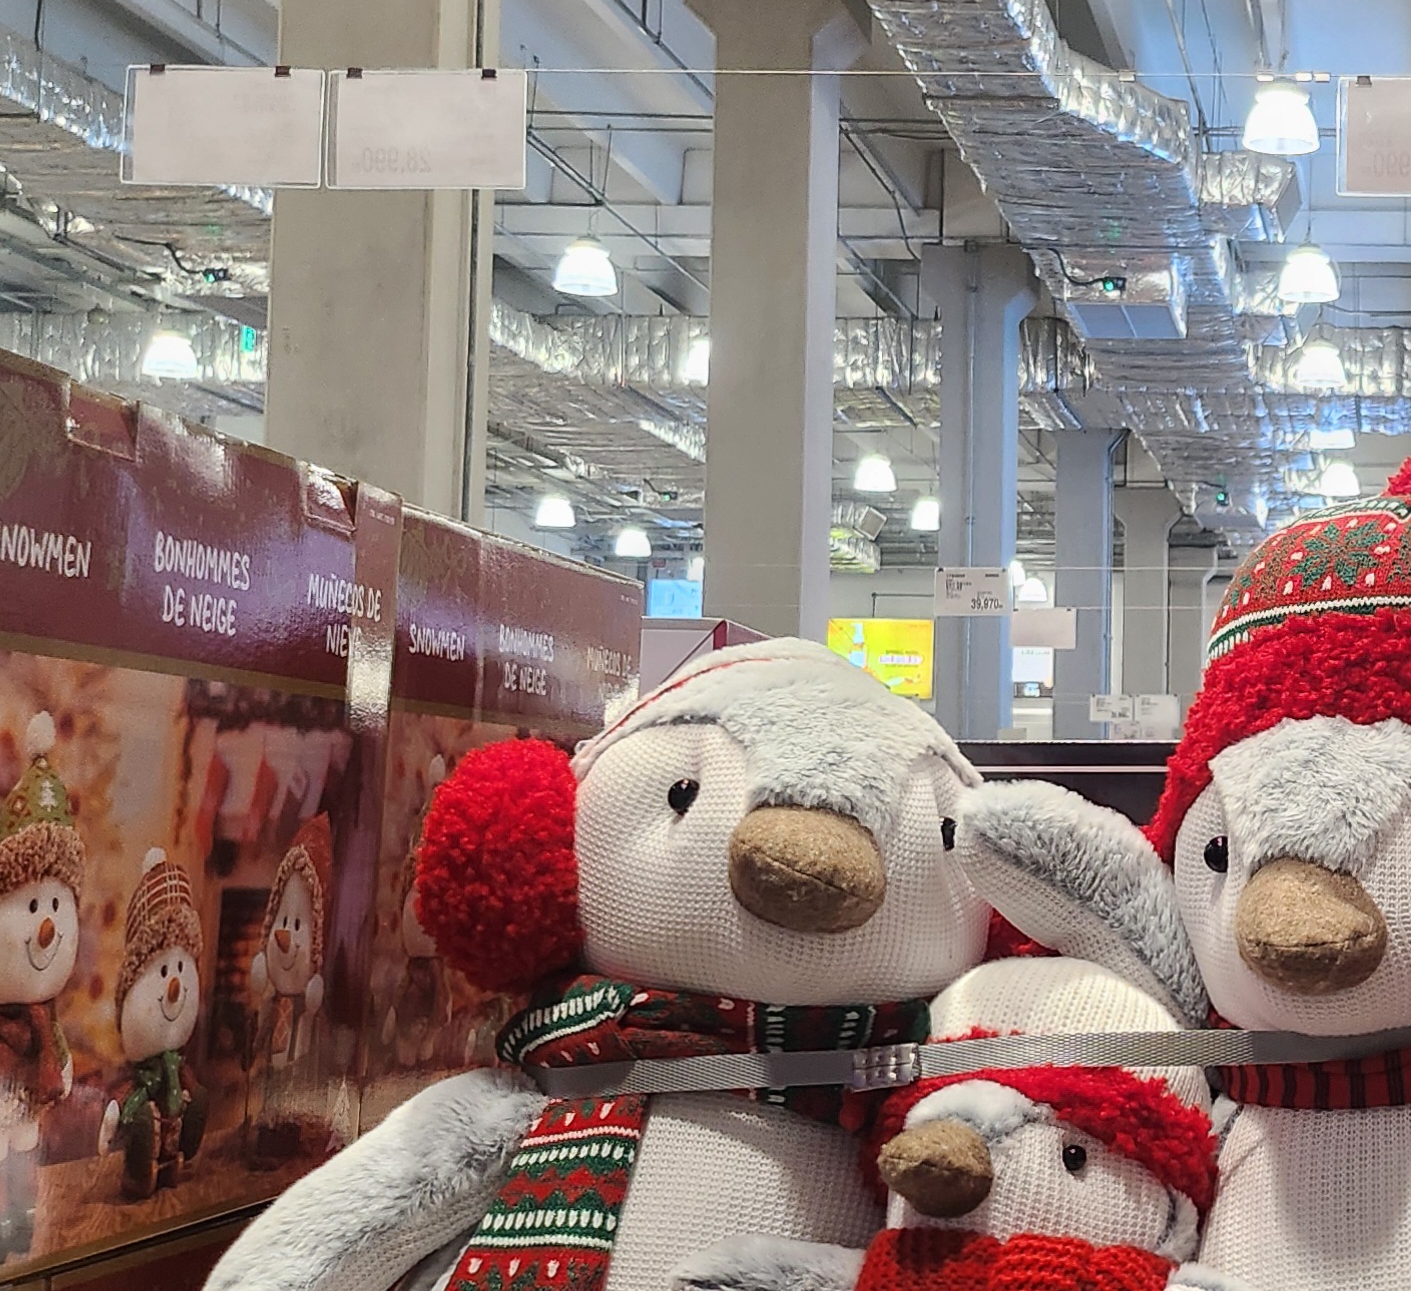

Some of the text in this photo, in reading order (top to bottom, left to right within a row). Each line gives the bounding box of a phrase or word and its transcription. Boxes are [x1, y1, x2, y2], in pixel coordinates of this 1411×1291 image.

[0, 523, 91, 578] NOWMEN
[154, 531, 251, 591] BONHOMMES
[162, 585, 238, 637] DE NEIGE
[307, 573, 382, 622] MUÑECOS DE
[971, 598, 1003, 610] 39,970
[409, 623, 465, 661] SNOWMEN
[499, 623, 555, 662] BONHOMMES
[504, 662, 547, 696] DE NEIGE
